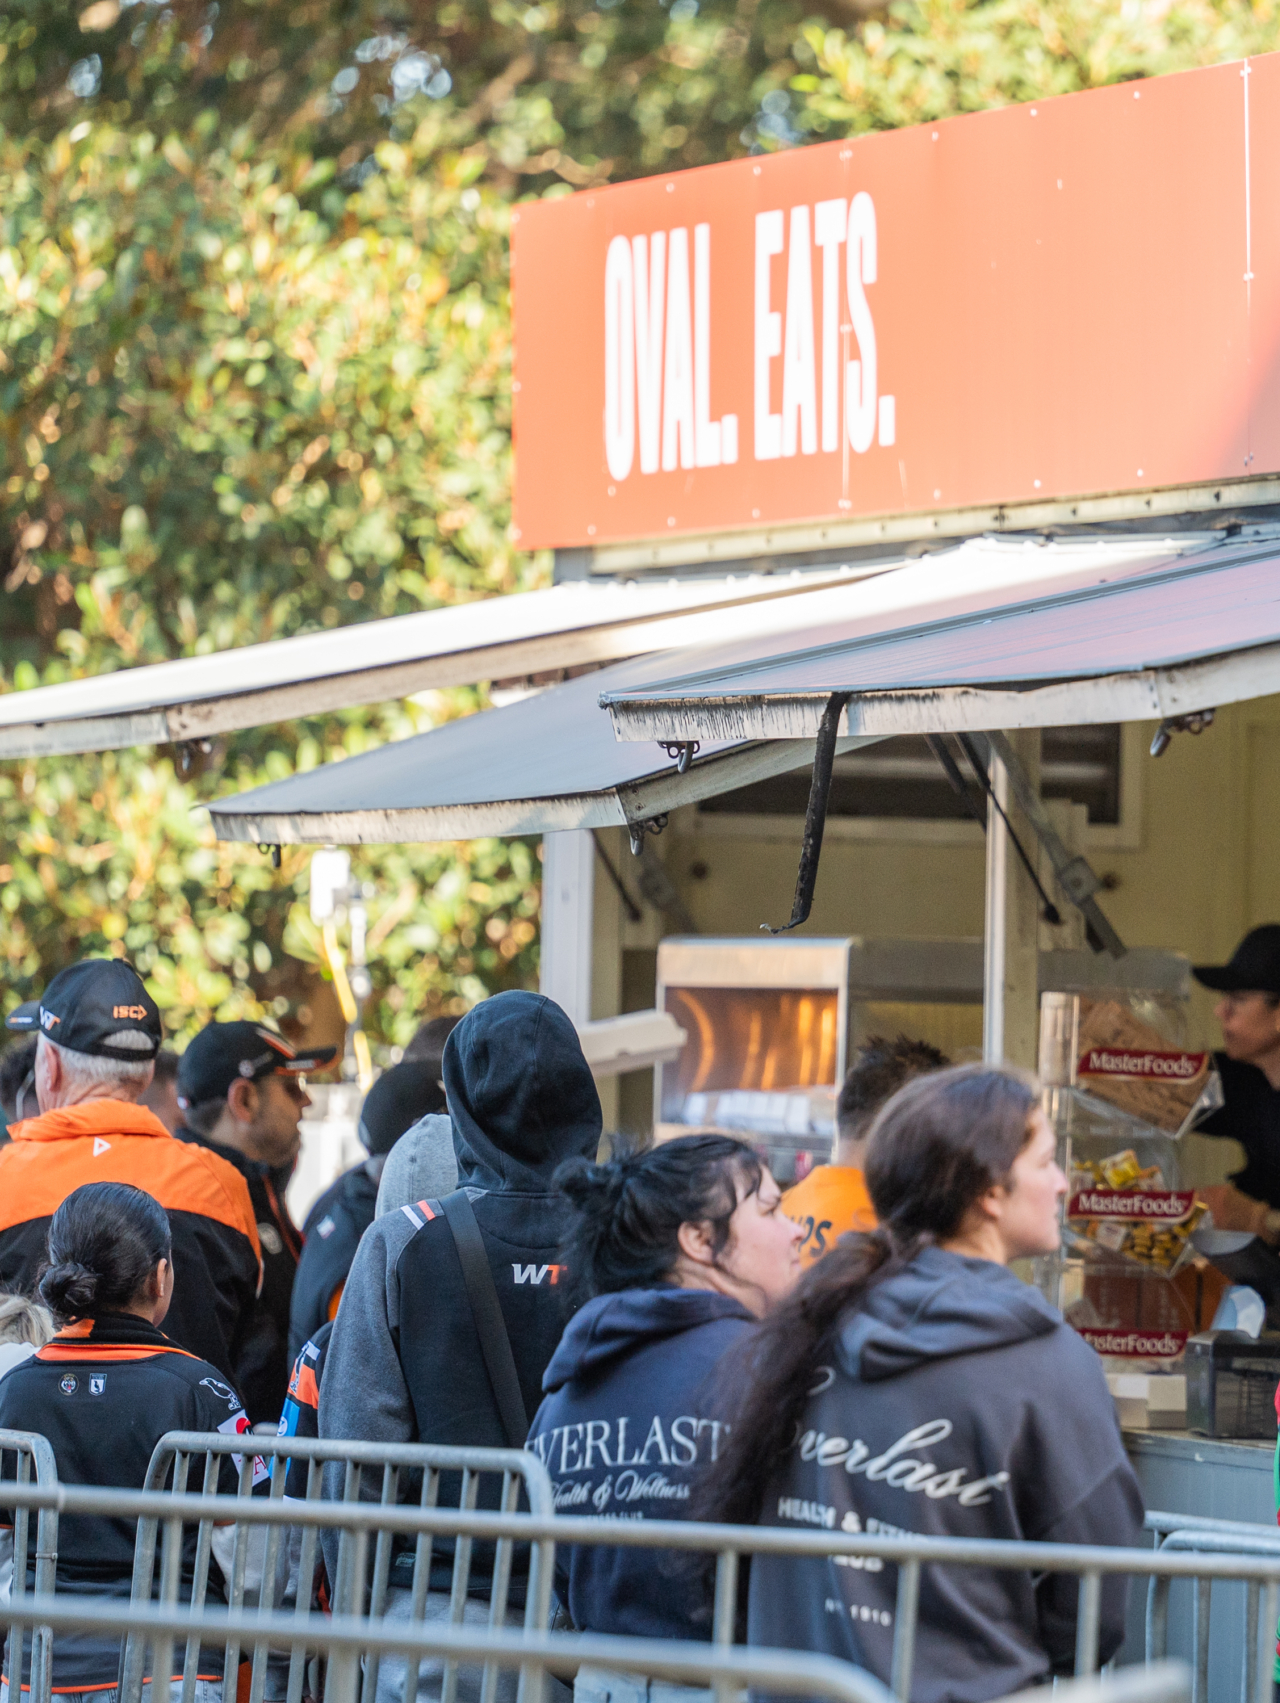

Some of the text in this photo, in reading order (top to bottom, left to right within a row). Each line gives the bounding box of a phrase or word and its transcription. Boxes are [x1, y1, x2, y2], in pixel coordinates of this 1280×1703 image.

[604, 191, 896, 482] OVAL. EATS.
[796, 1400, 1011, 1507] verlast
